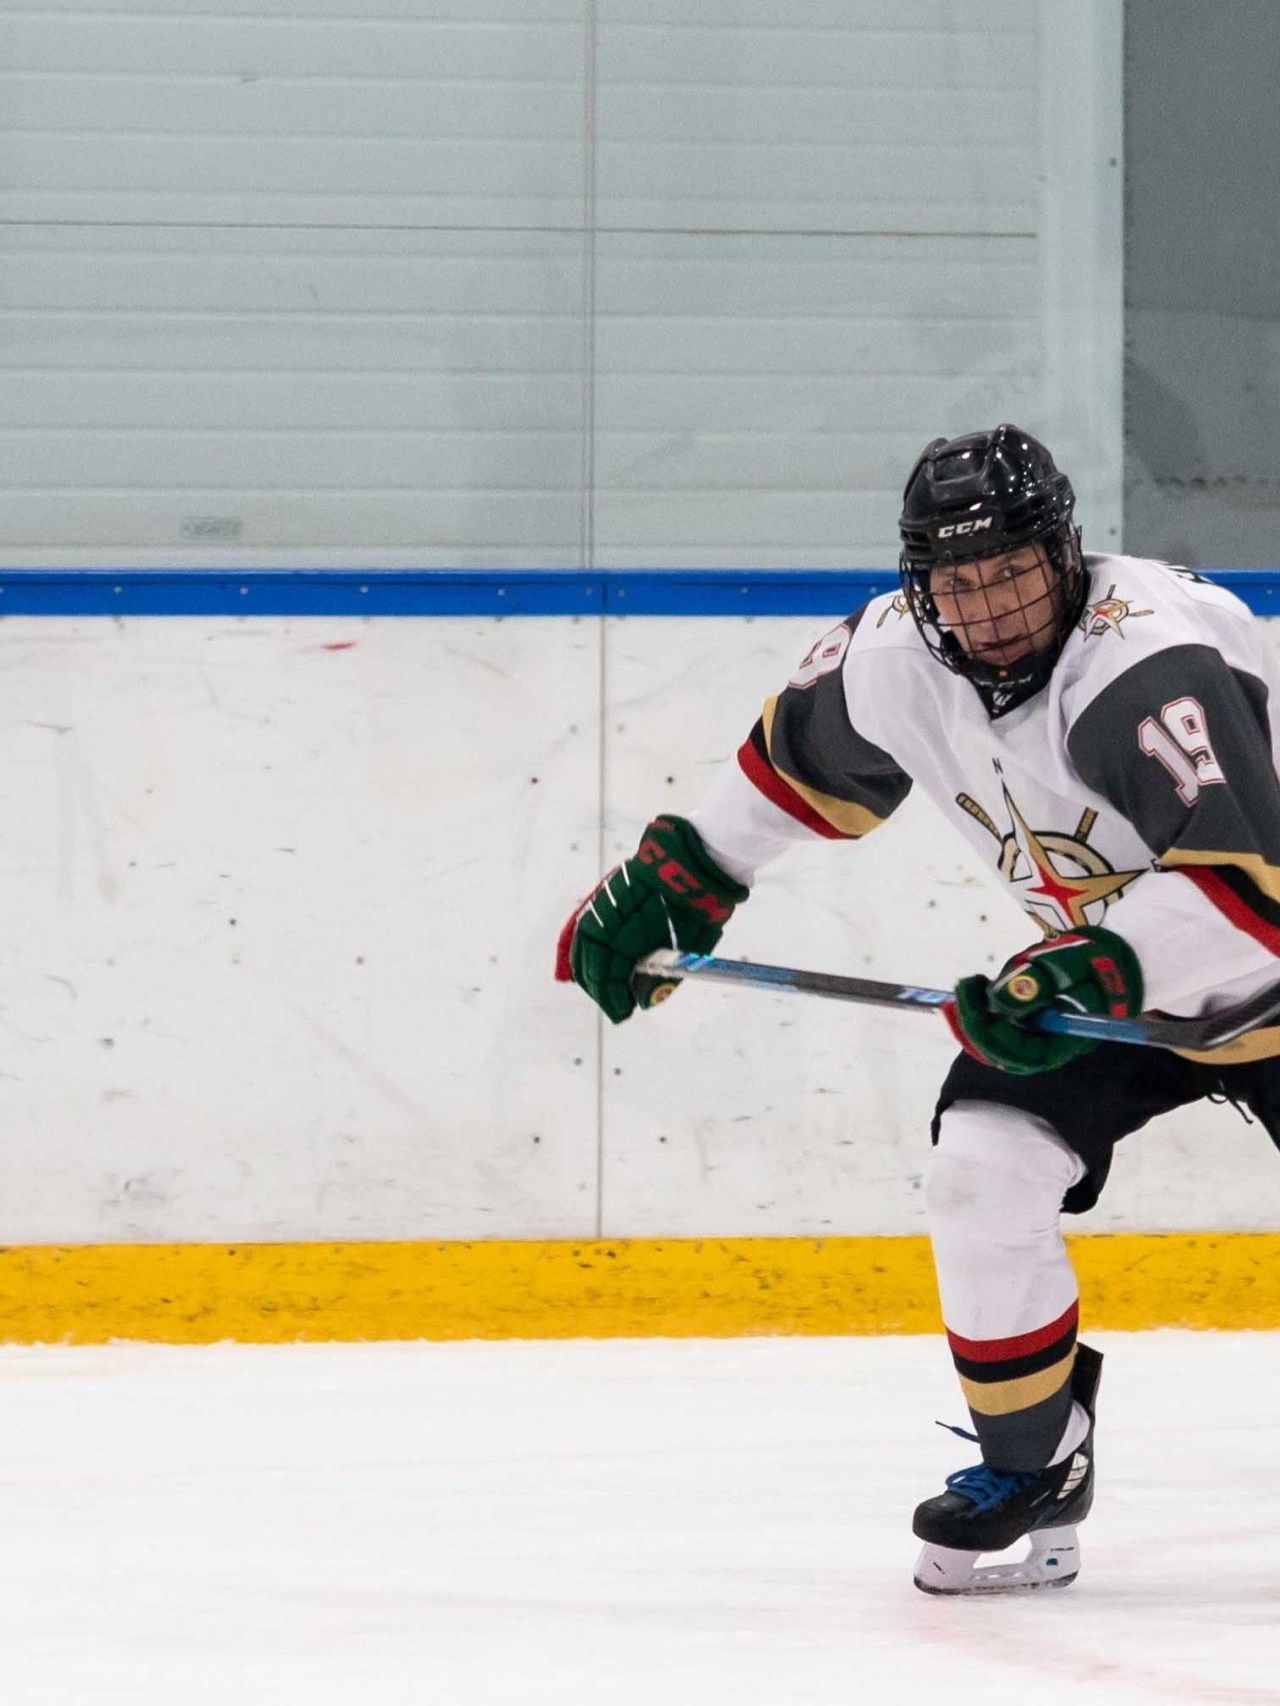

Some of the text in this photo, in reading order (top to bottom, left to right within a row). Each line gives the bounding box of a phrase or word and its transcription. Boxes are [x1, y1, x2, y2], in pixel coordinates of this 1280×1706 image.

[937, 516, 993, 539] CCM
[787, 623, 852, 690] 9
[1137, 696, 1227, 808] 19
[638, 838, 730, 924] CCM
